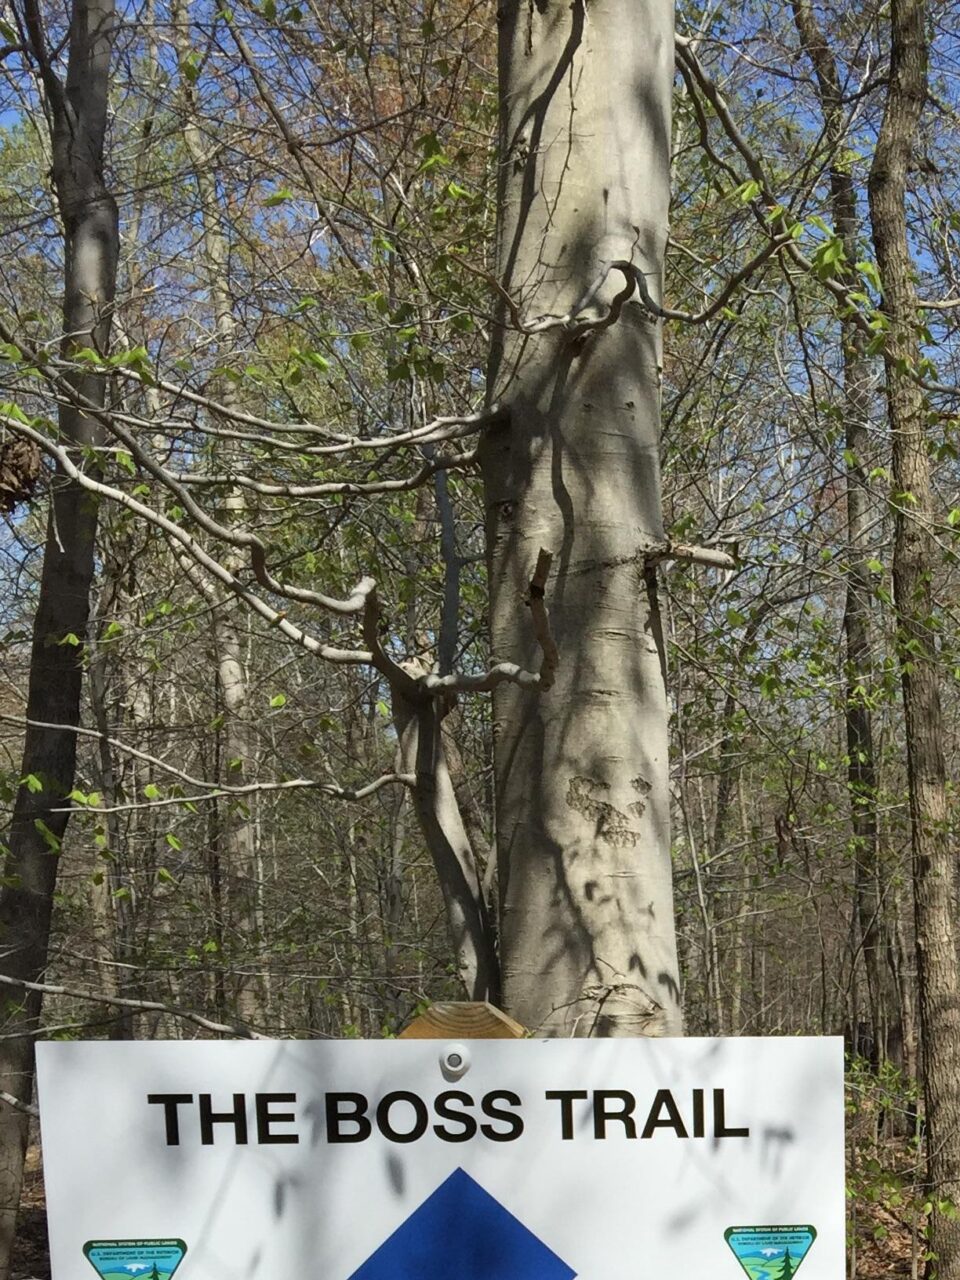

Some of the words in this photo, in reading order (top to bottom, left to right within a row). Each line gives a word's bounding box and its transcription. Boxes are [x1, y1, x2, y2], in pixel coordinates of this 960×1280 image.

[147, 1092, 300, 1146] THE
[324, 1089, 524, 1144] BOSS
[545, 1088, 750, 1140] TRAIL
